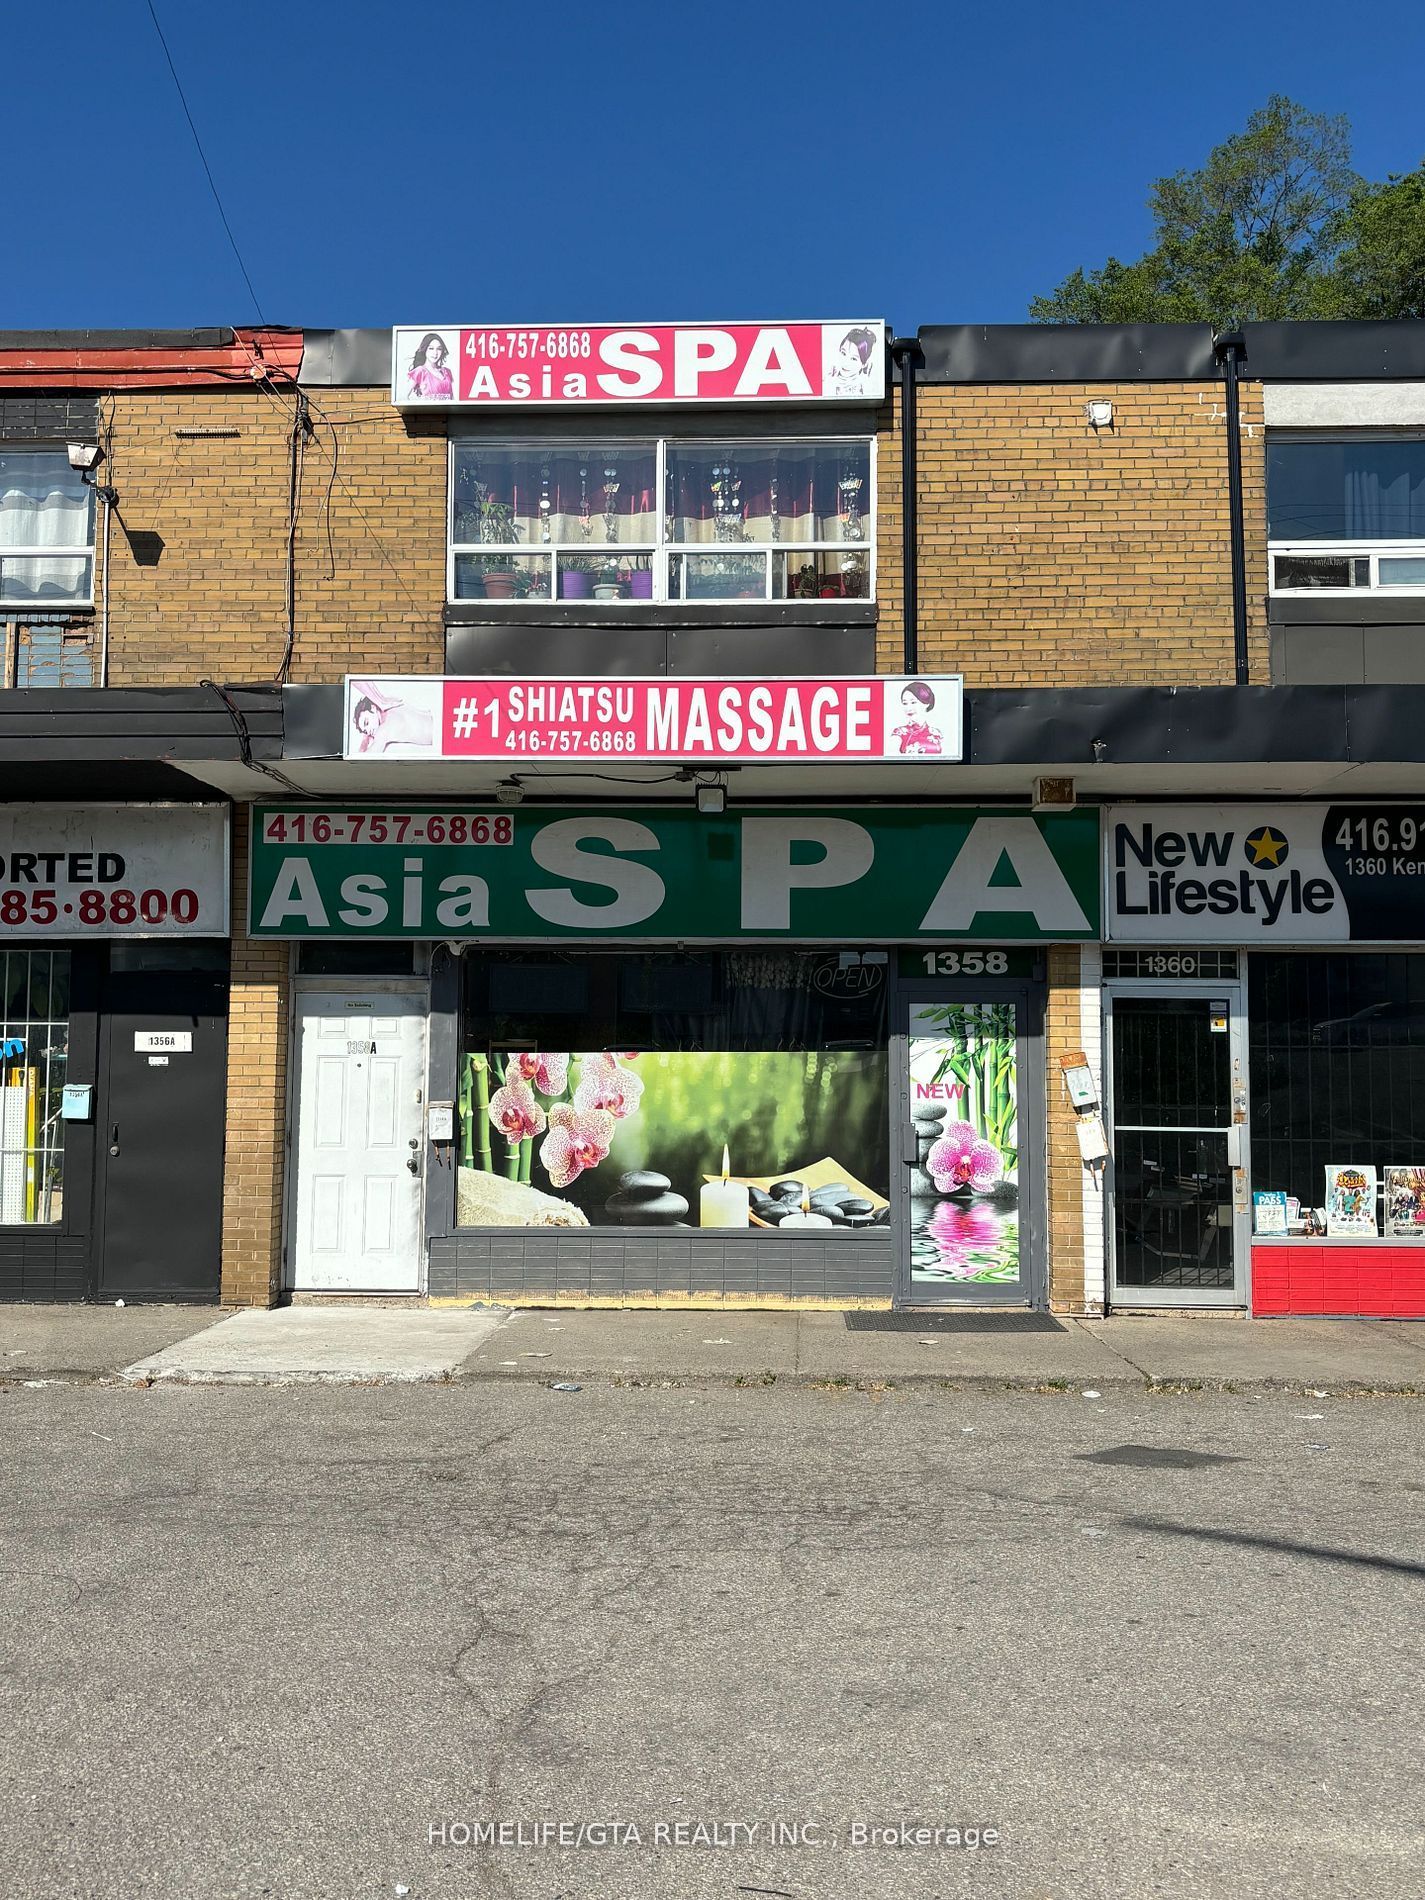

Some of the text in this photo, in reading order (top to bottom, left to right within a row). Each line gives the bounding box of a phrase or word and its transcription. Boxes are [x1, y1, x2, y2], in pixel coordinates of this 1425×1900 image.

[465, 332, 591, 359] 416-757-6868
[596, 328, 815, 397] SPA
[468, 365, 588, 398] Asia
[453, 698, 500, 739] #1
[508, 686, 635, 723] SHIATSU
[646, 686, 871, 752] MASSAGE
[505, 730, 636, 752] 416-757-6868
[266, 814, 513, 845] 416-757-6868
[1115, 823, 1235, 867] New
[0, 853, 126, 883] RTED
[524, 816, 1094, 930] SPA
[1345, 857, 1387, 876] 1360
[259, 857, 491, 928] Asia
[1116, 869, 1335, 926] Lifestyle
[816, 966, 876, 988] OPEN
[922, 951, 1009, 975] 1358
[1145, 956, 1196, 974] 1360
[916, 1083, 965, 1099] NEW
